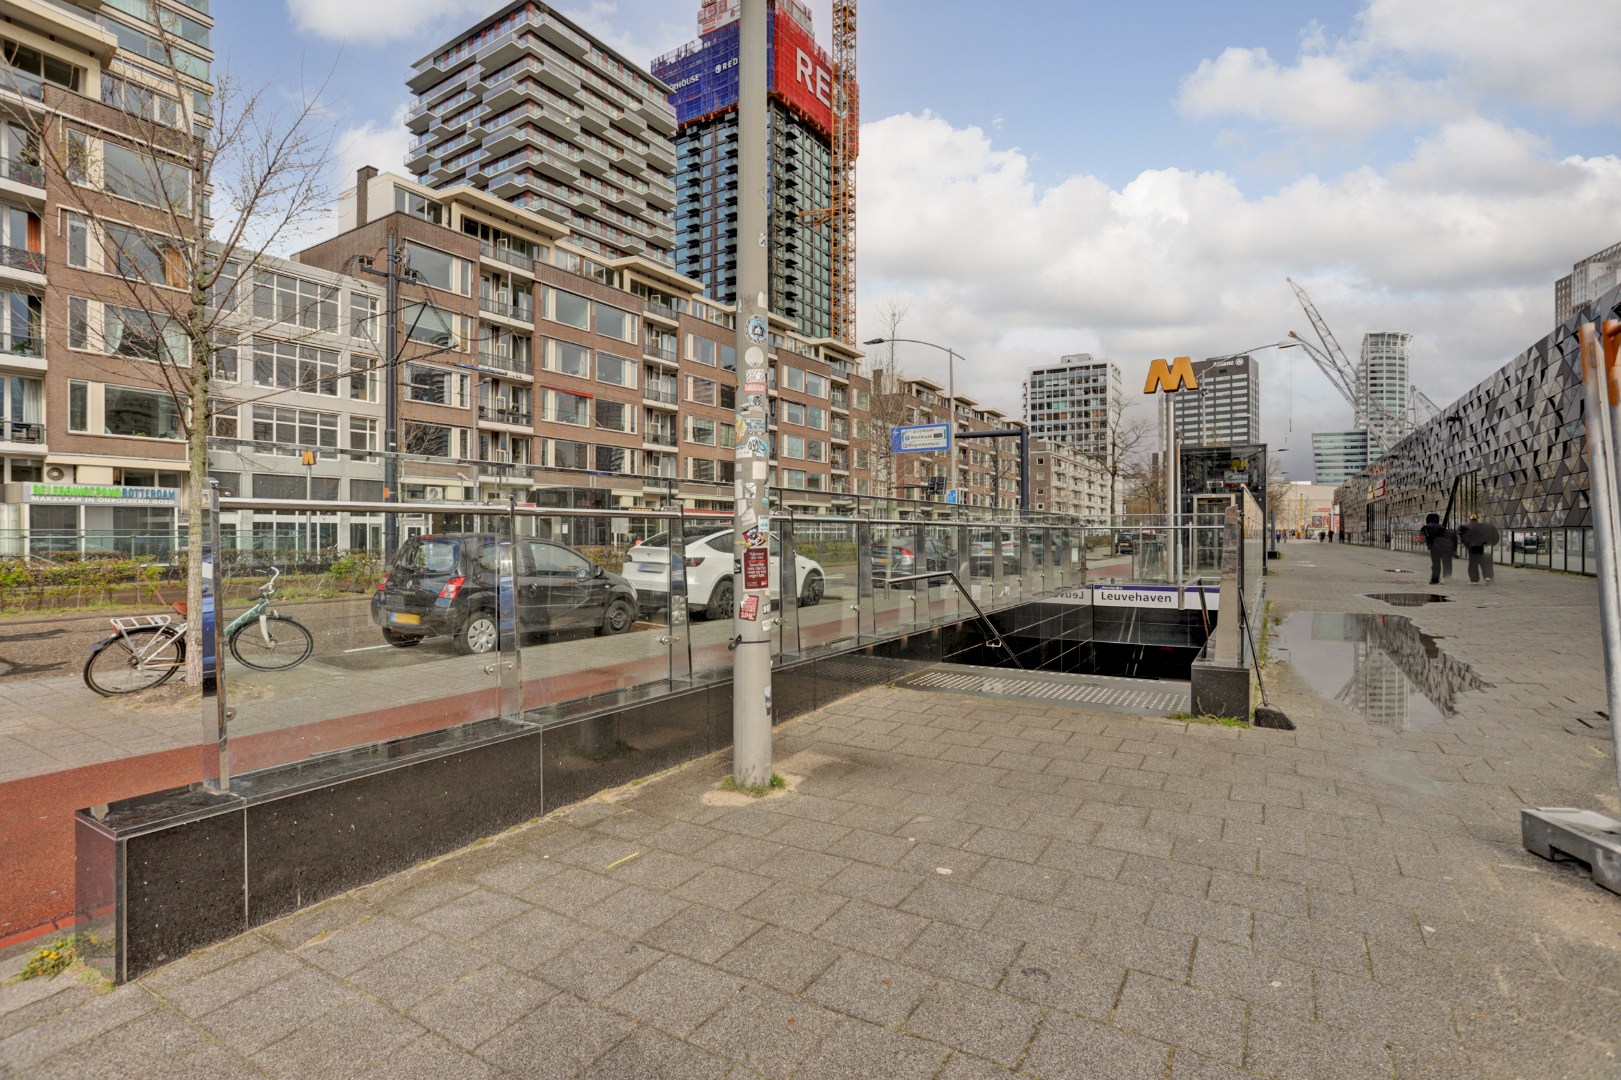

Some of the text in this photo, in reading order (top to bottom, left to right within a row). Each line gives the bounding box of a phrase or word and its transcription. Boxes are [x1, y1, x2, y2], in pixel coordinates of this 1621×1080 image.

[796, 46, 835, 109] RE
[98, 497, 150, 505] ONROEREND
[1101, 591, 1172, 603] Leuvehaven
